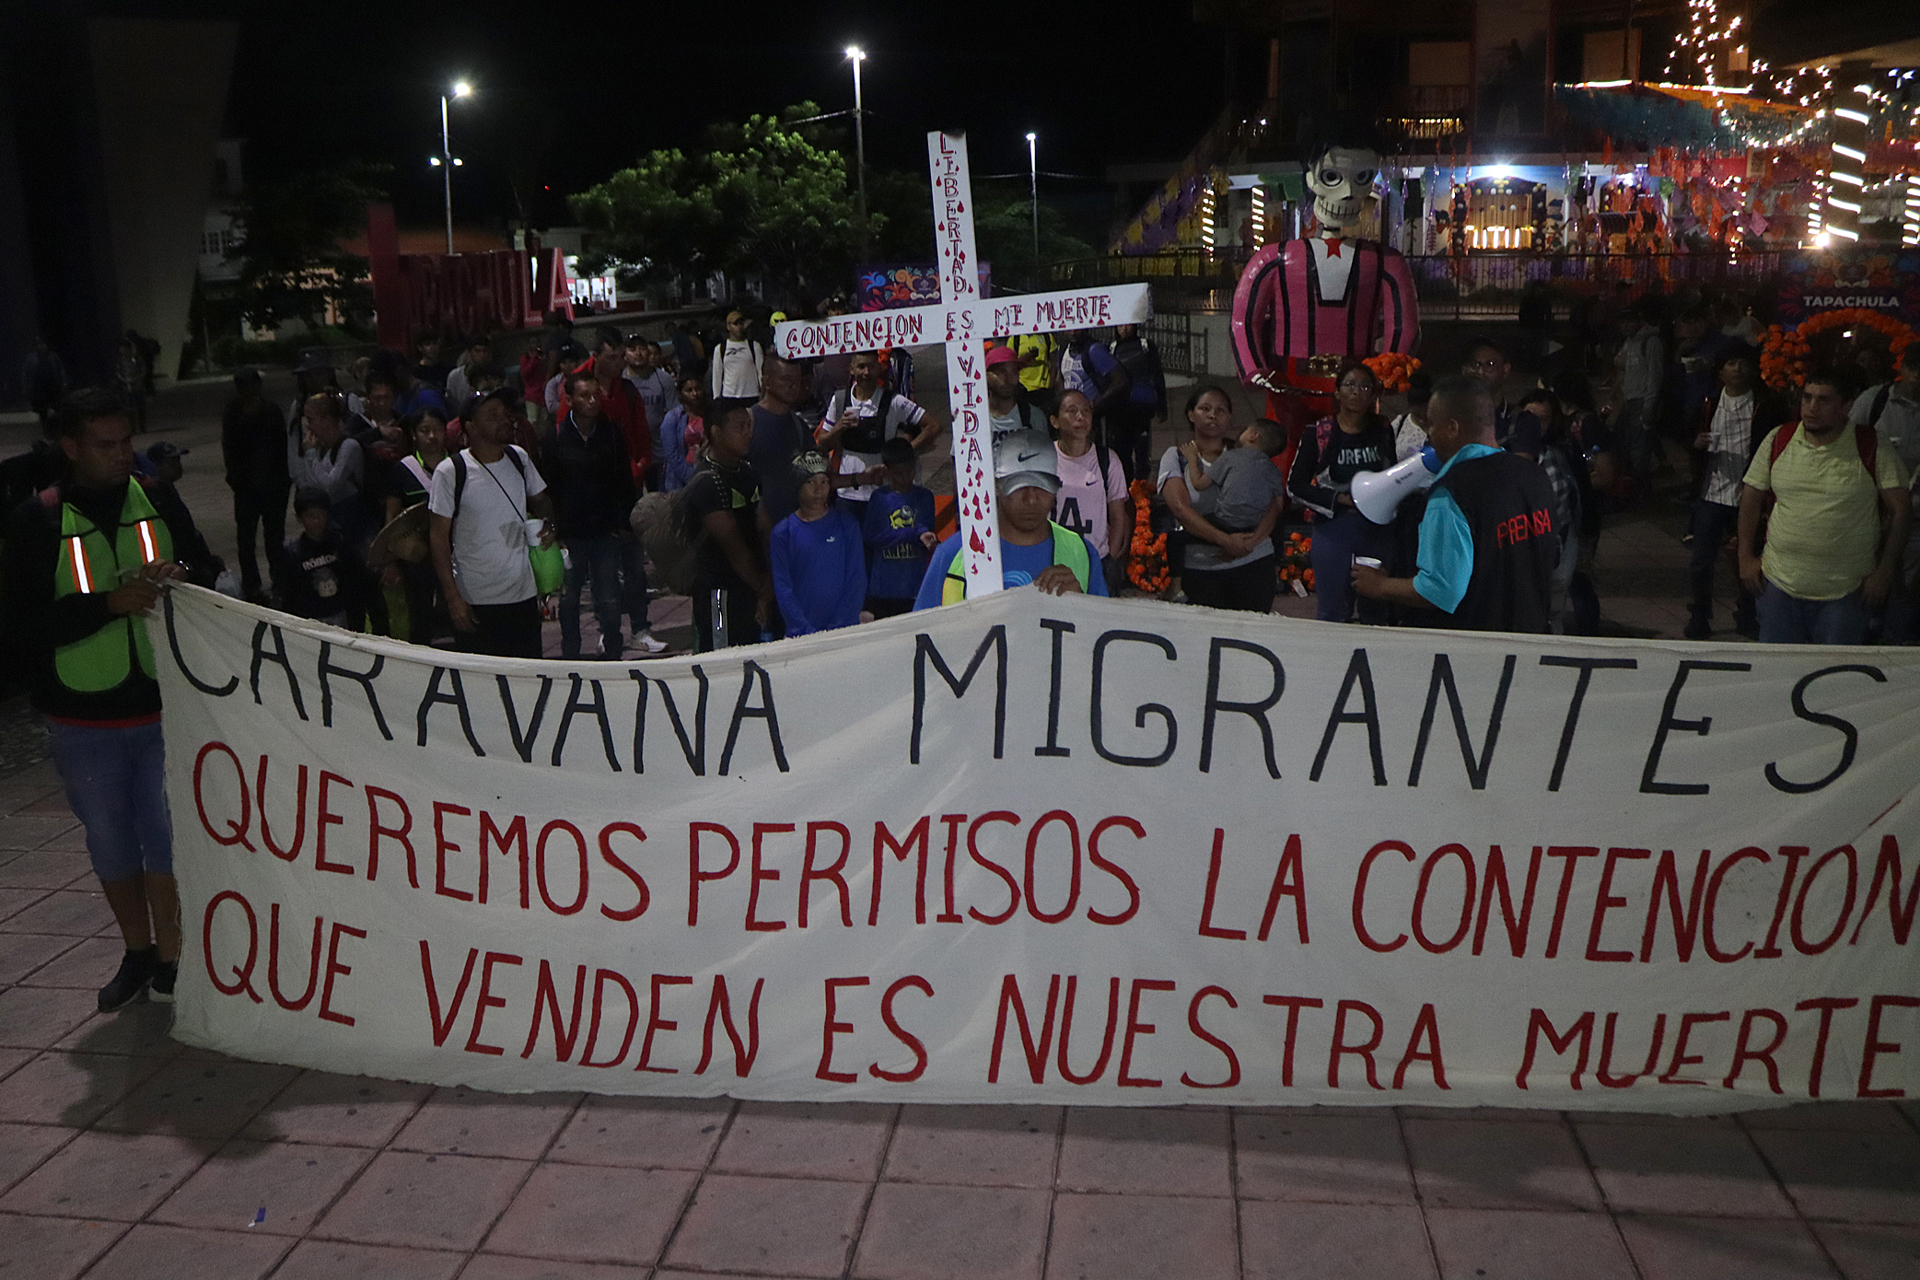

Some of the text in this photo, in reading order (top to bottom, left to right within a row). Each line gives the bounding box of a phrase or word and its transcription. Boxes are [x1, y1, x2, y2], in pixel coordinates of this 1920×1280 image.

[940, 132, 967, 294] LIBERTAD
[786, 295, 1110, 350] CONTENCION ES MI MUERTE
[1802, 295, 1900, 308] TAPACHULA
[957, 355, 983, 462] VIDA
[1496, 508, 1553, 550] PRENSA
[163, 586, 1889, 796] CARAVANA MIGRANTES
[193, 741, 1920, 964] QUEREMOS PERMISOS LA CONTENCION
[202, 889, 1920, 1099] QUE VENDEN ES NUESTRA MUERTE
